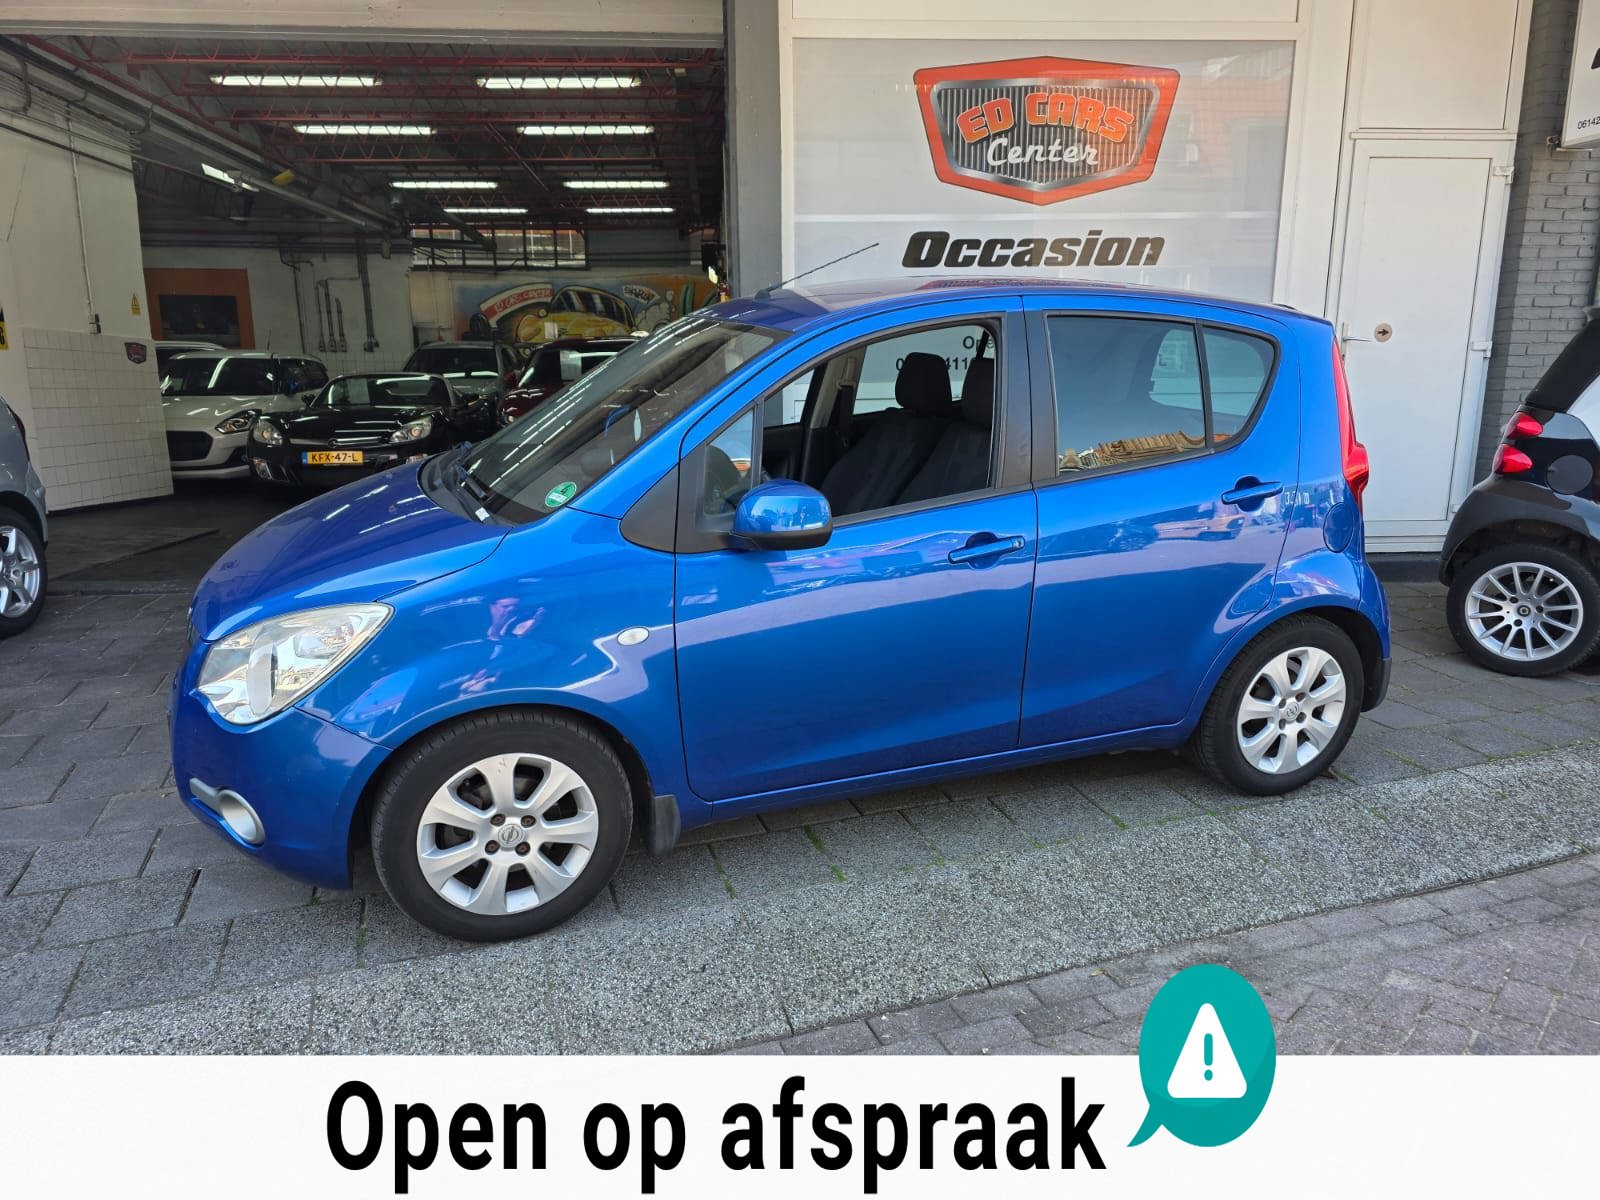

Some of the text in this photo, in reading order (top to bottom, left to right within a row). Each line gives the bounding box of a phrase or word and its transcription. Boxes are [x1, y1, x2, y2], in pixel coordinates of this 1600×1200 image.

[957, 92, 1135, 144] ED CARS
[987, 138, 1099, 166] Center
[901, 229, 1166, 268] Occasion
[311, 452, 359, 463] KFX-47-L
